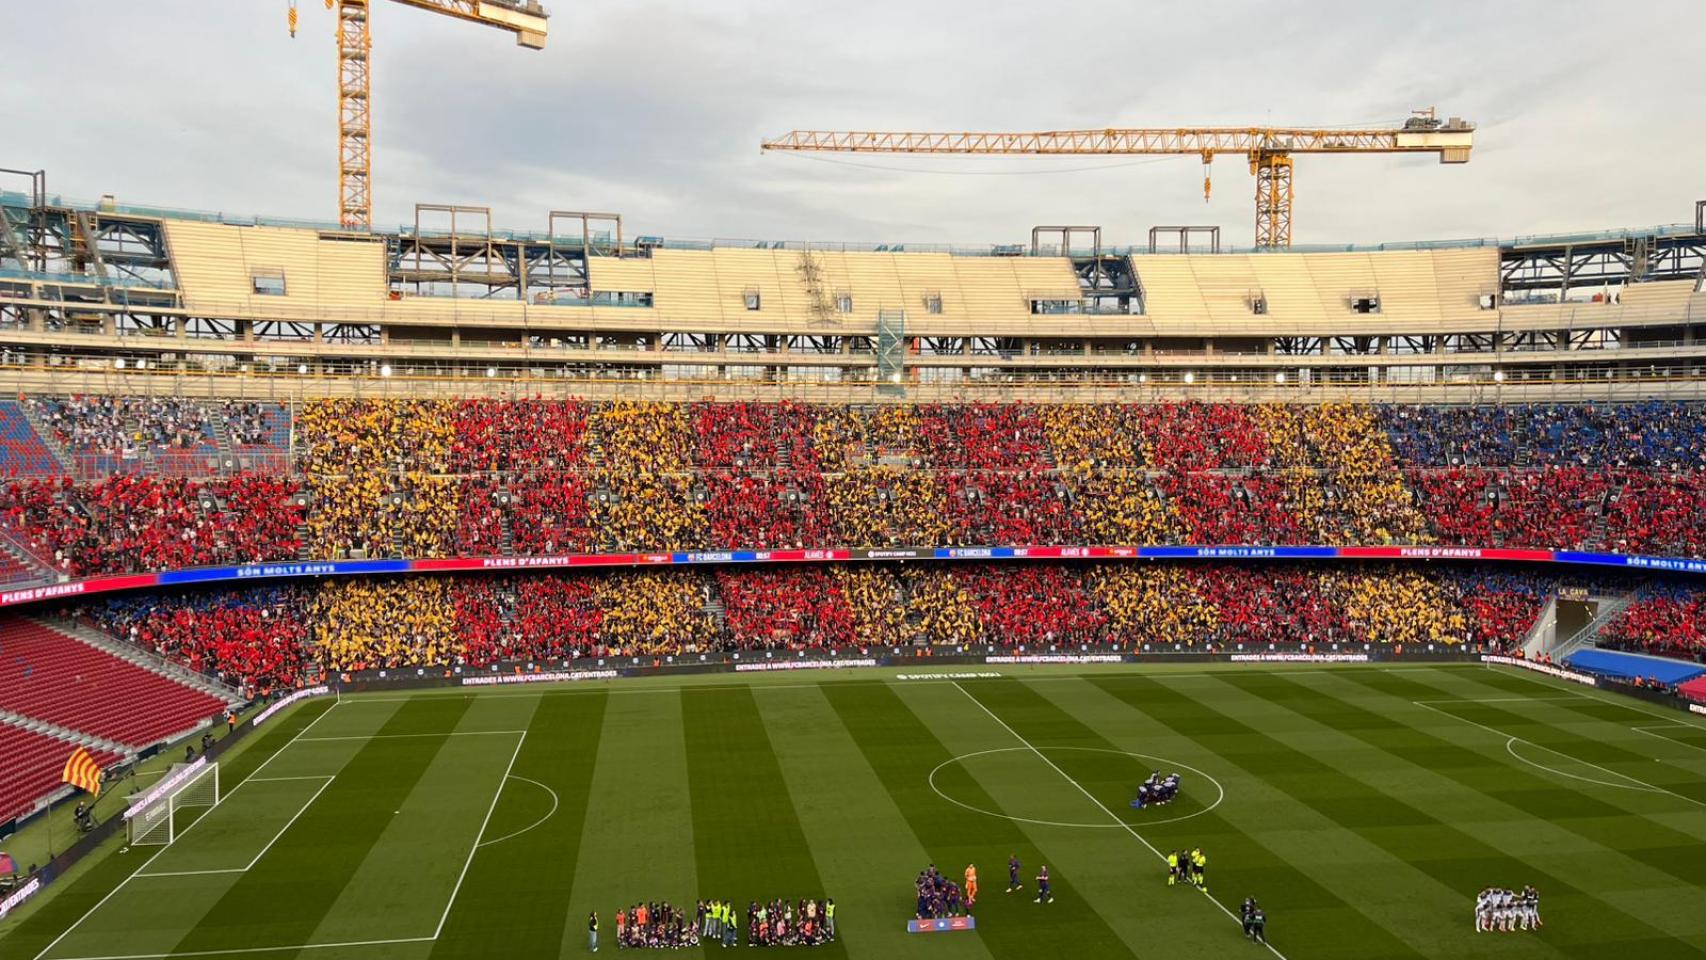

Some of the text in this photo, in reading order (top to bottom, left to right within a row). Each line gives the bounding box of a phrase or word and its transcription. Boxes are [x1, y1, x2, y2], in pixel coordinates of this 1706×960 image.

[1219, 548, 1248, 556] MOLTS
[1250, 548, 1275, 556] ANYS
[1400, 548, 1430, 556] PLENS
[484, 558, 516, 567] PLENS
[1626, 556, 1648, 565] SÓN
[1650, 559, 1686, 569] MOLTS
[237, 564, 336, 577] SÓN MOLTS ANYS
[1, 589, 34, 603] PLENS
[462, 676, 497, 685] ENTRADES
